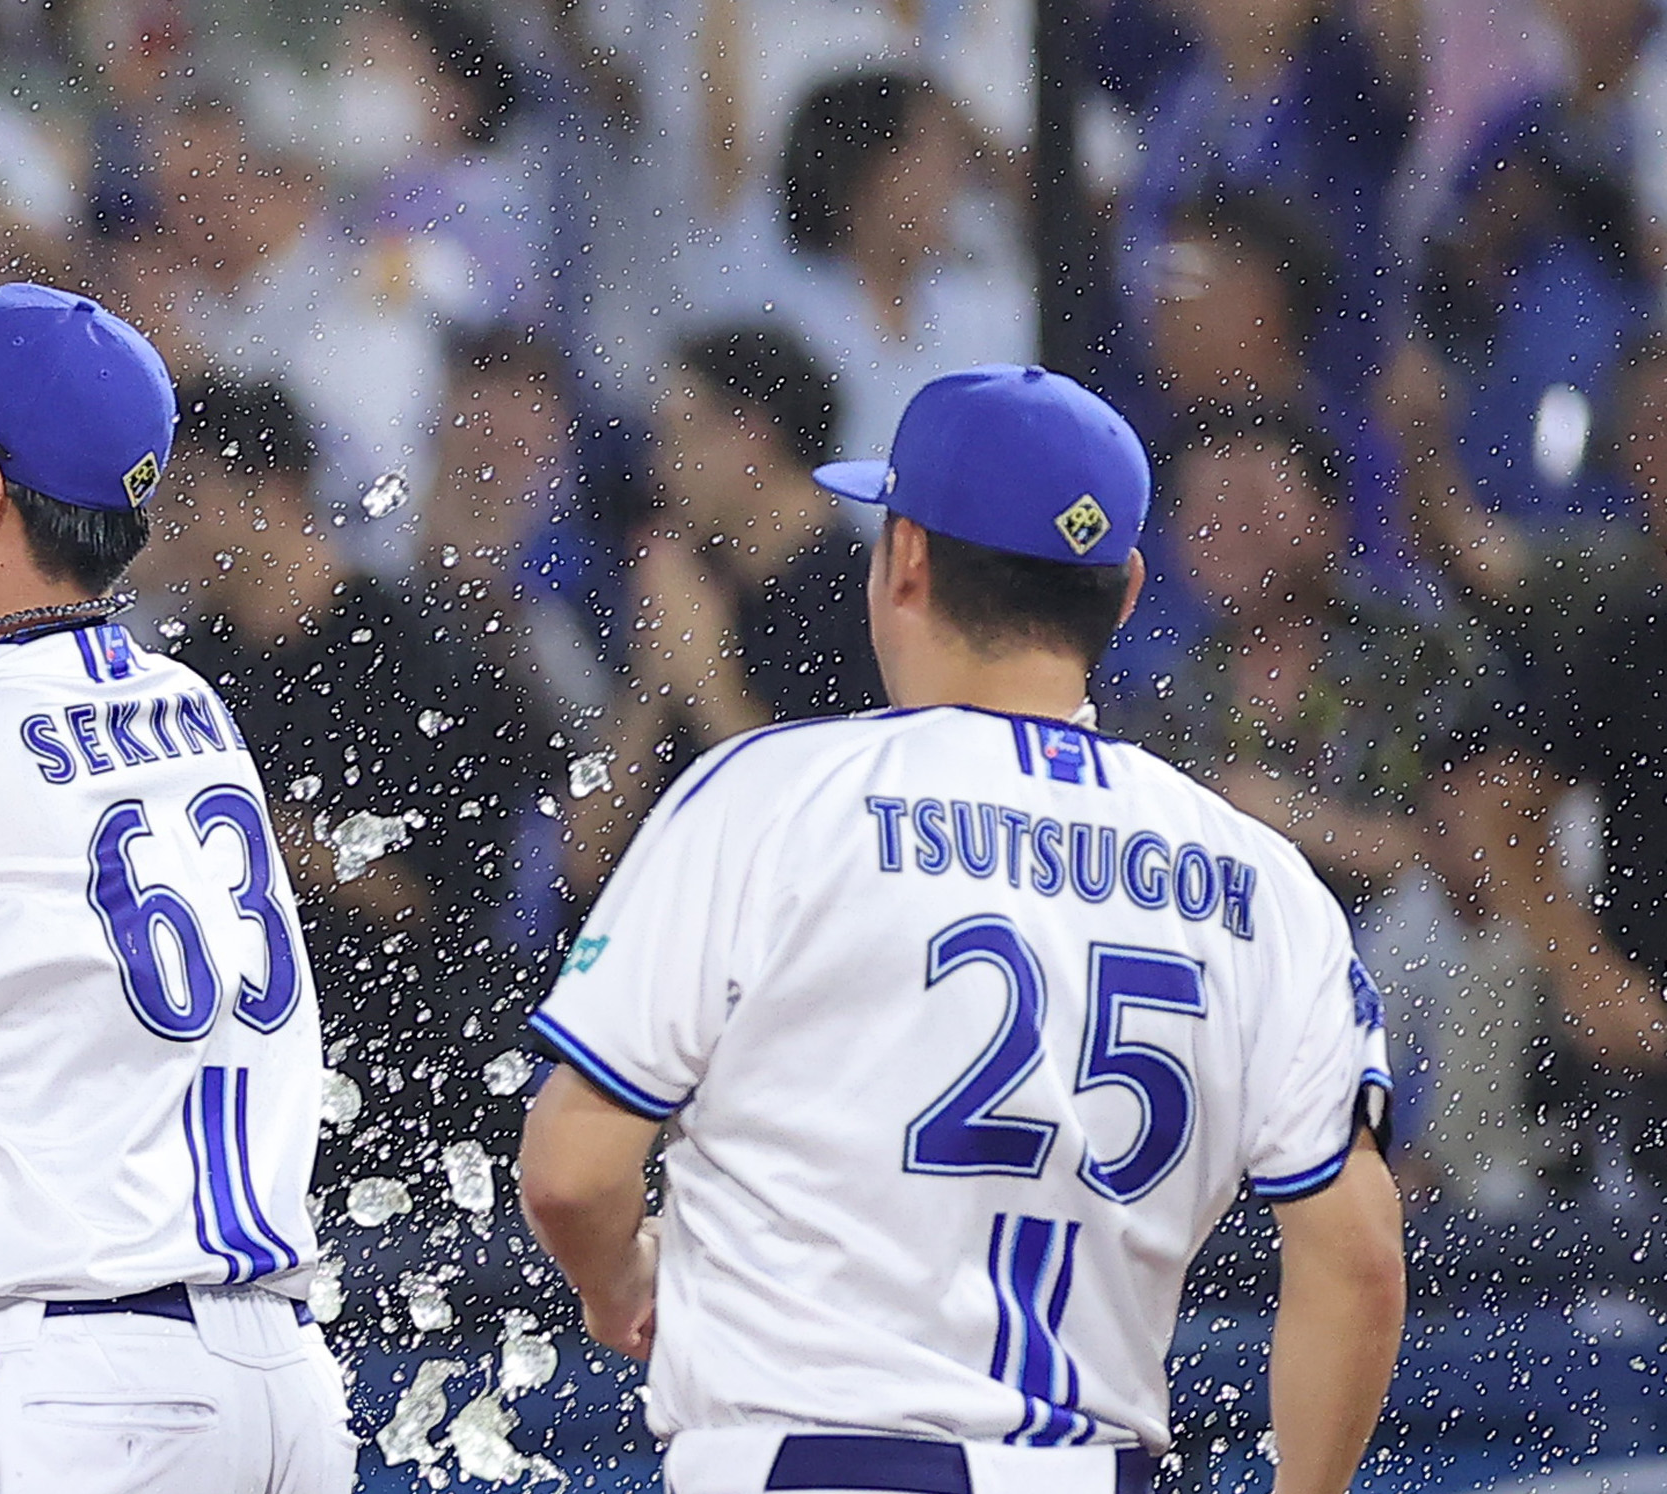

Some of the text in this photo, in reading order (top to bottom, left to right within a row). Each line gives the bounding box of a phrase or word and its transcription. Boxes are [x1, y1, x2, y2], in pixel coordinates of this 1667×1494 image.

[86, 783, 302, 1043] 63
[865, 795, 1257, 942] TSUTSUGOH
[902, 912, 1208, 1206] 25
